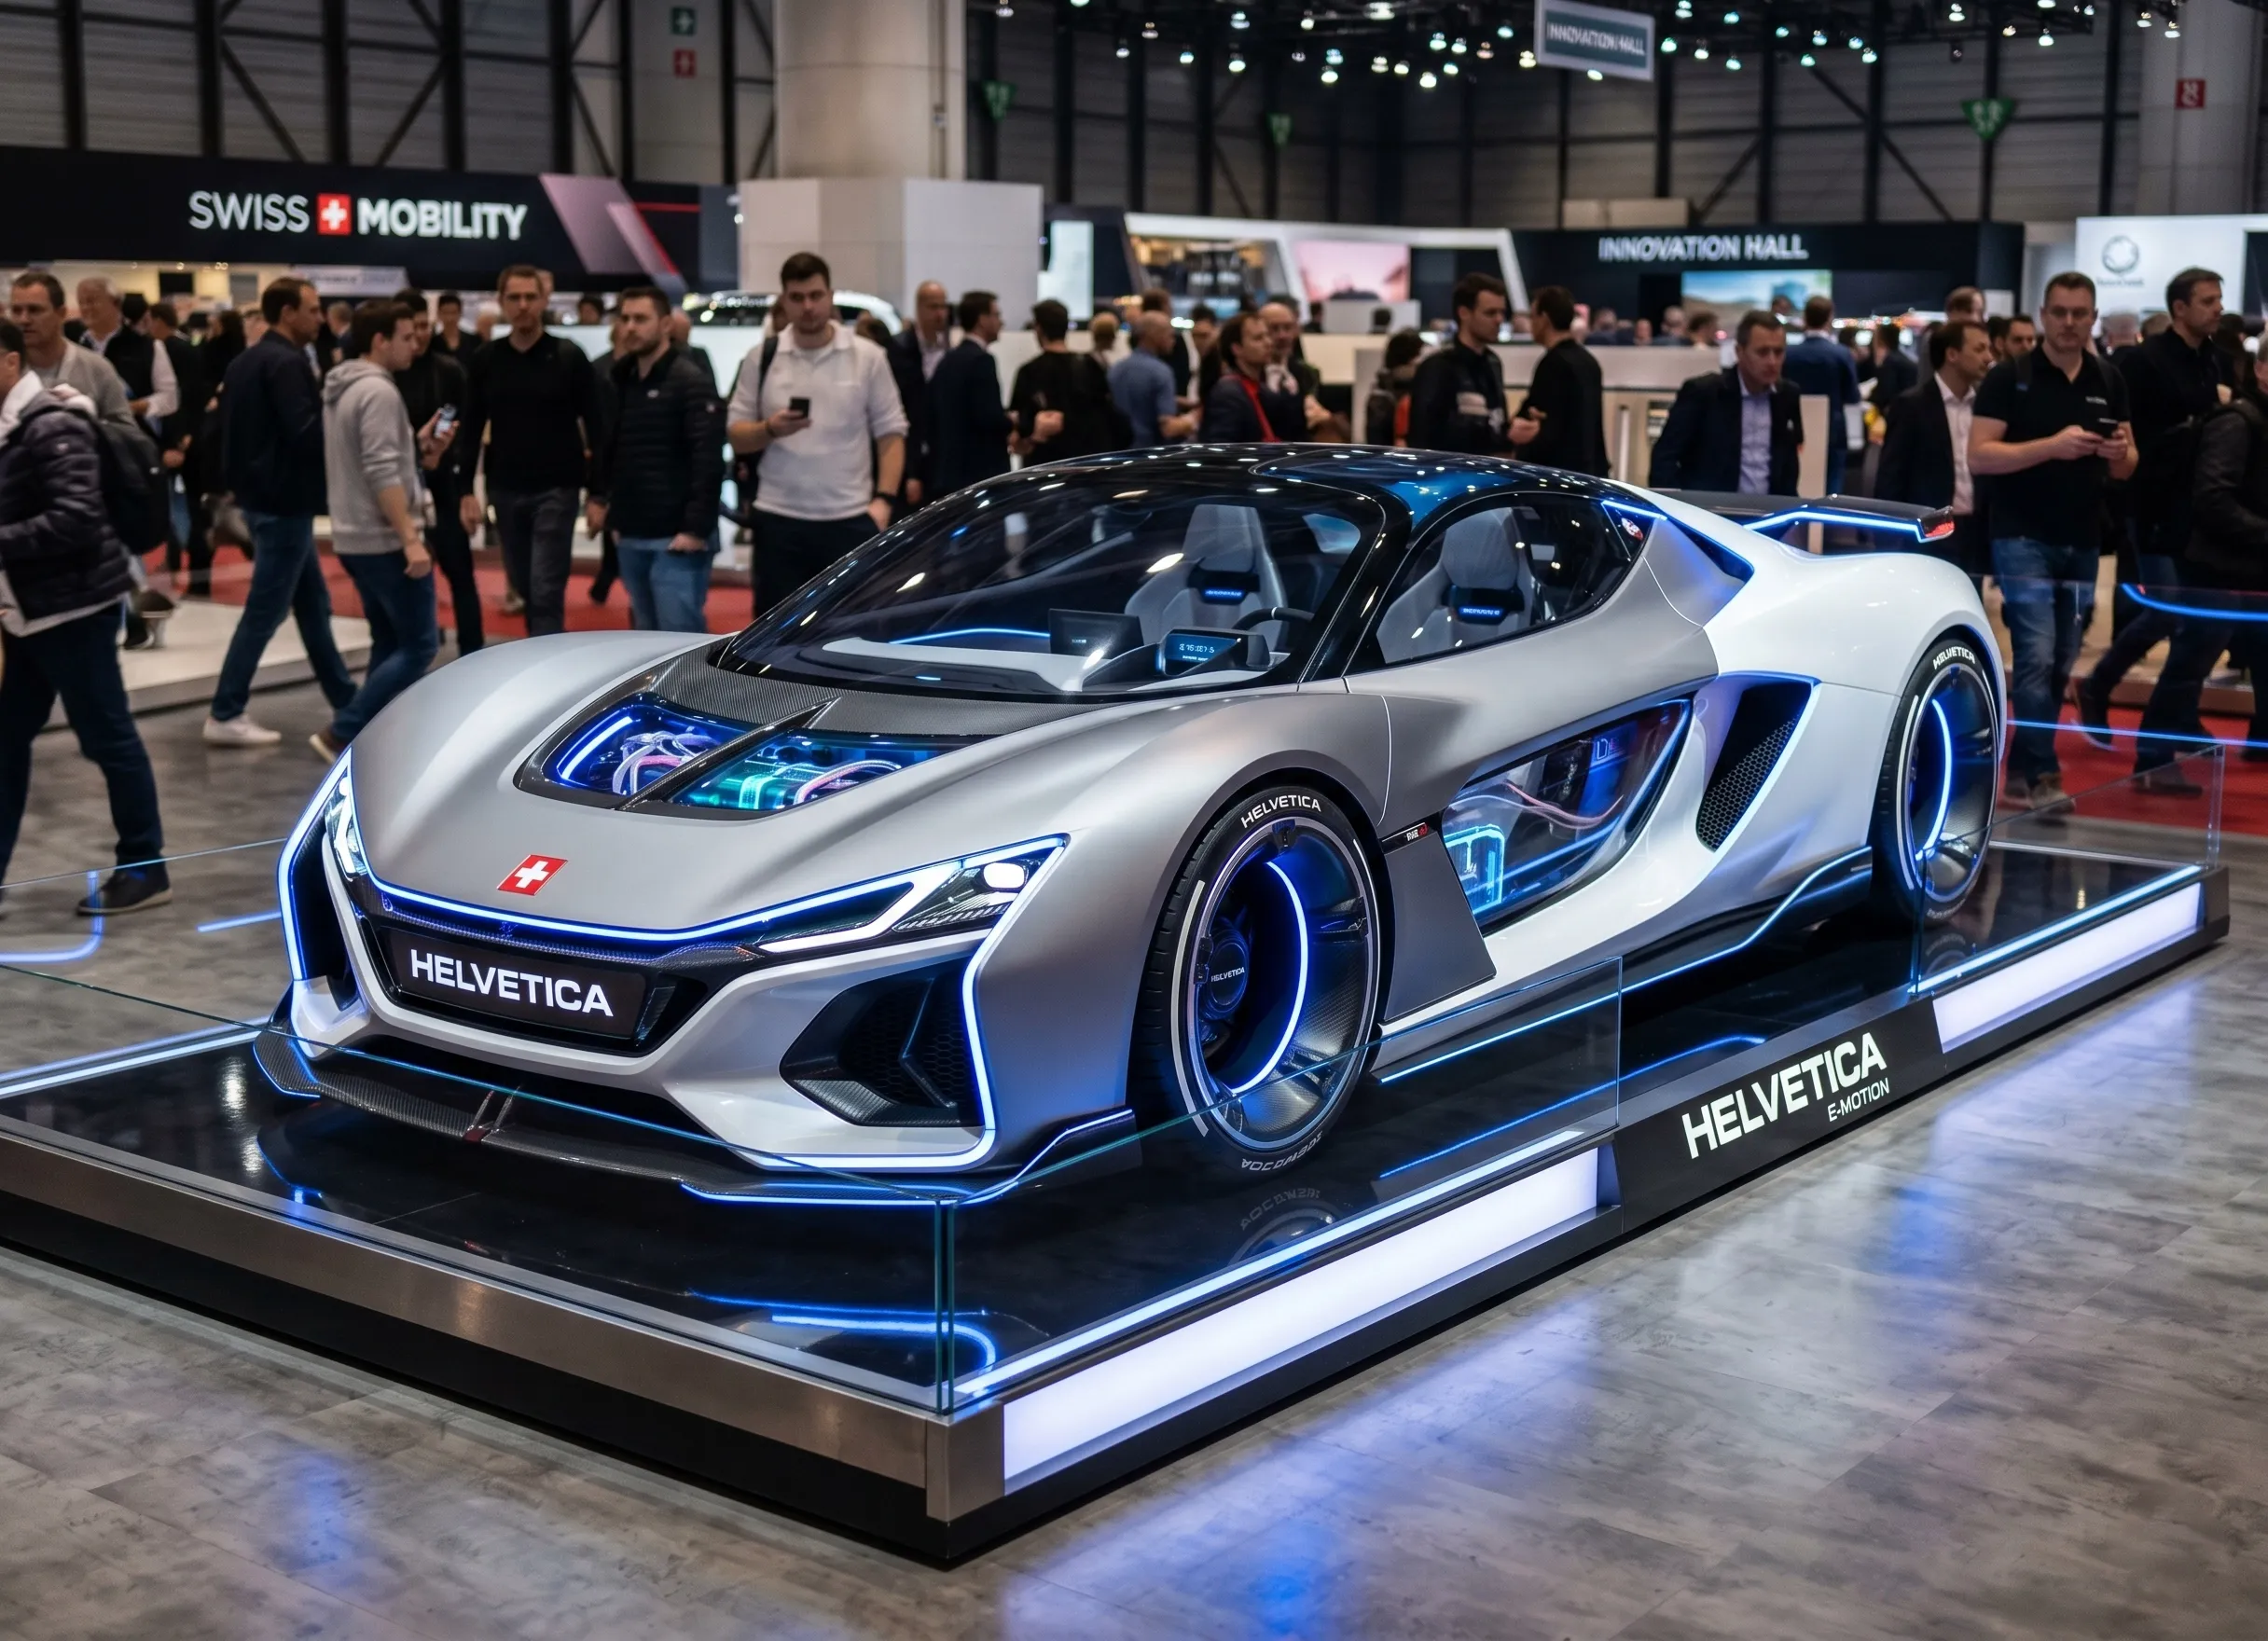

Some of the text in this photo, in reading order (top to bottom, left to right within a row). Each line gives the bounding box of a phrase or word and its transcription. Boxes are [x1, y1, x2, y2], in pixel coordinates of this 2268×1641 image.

[188, 190, 528, 241] SWISS MOBILITY
[1597, 233, 1810, 262] INNOVATION HALL
[1240, 794, 1321, 829] HELVETICA
[410, 948, 614, 1017] HELVETICA
[1681, 1031, 1888, 1160] HELVETICA
[1827, 1077, 1890, 1123] E-MOTION
